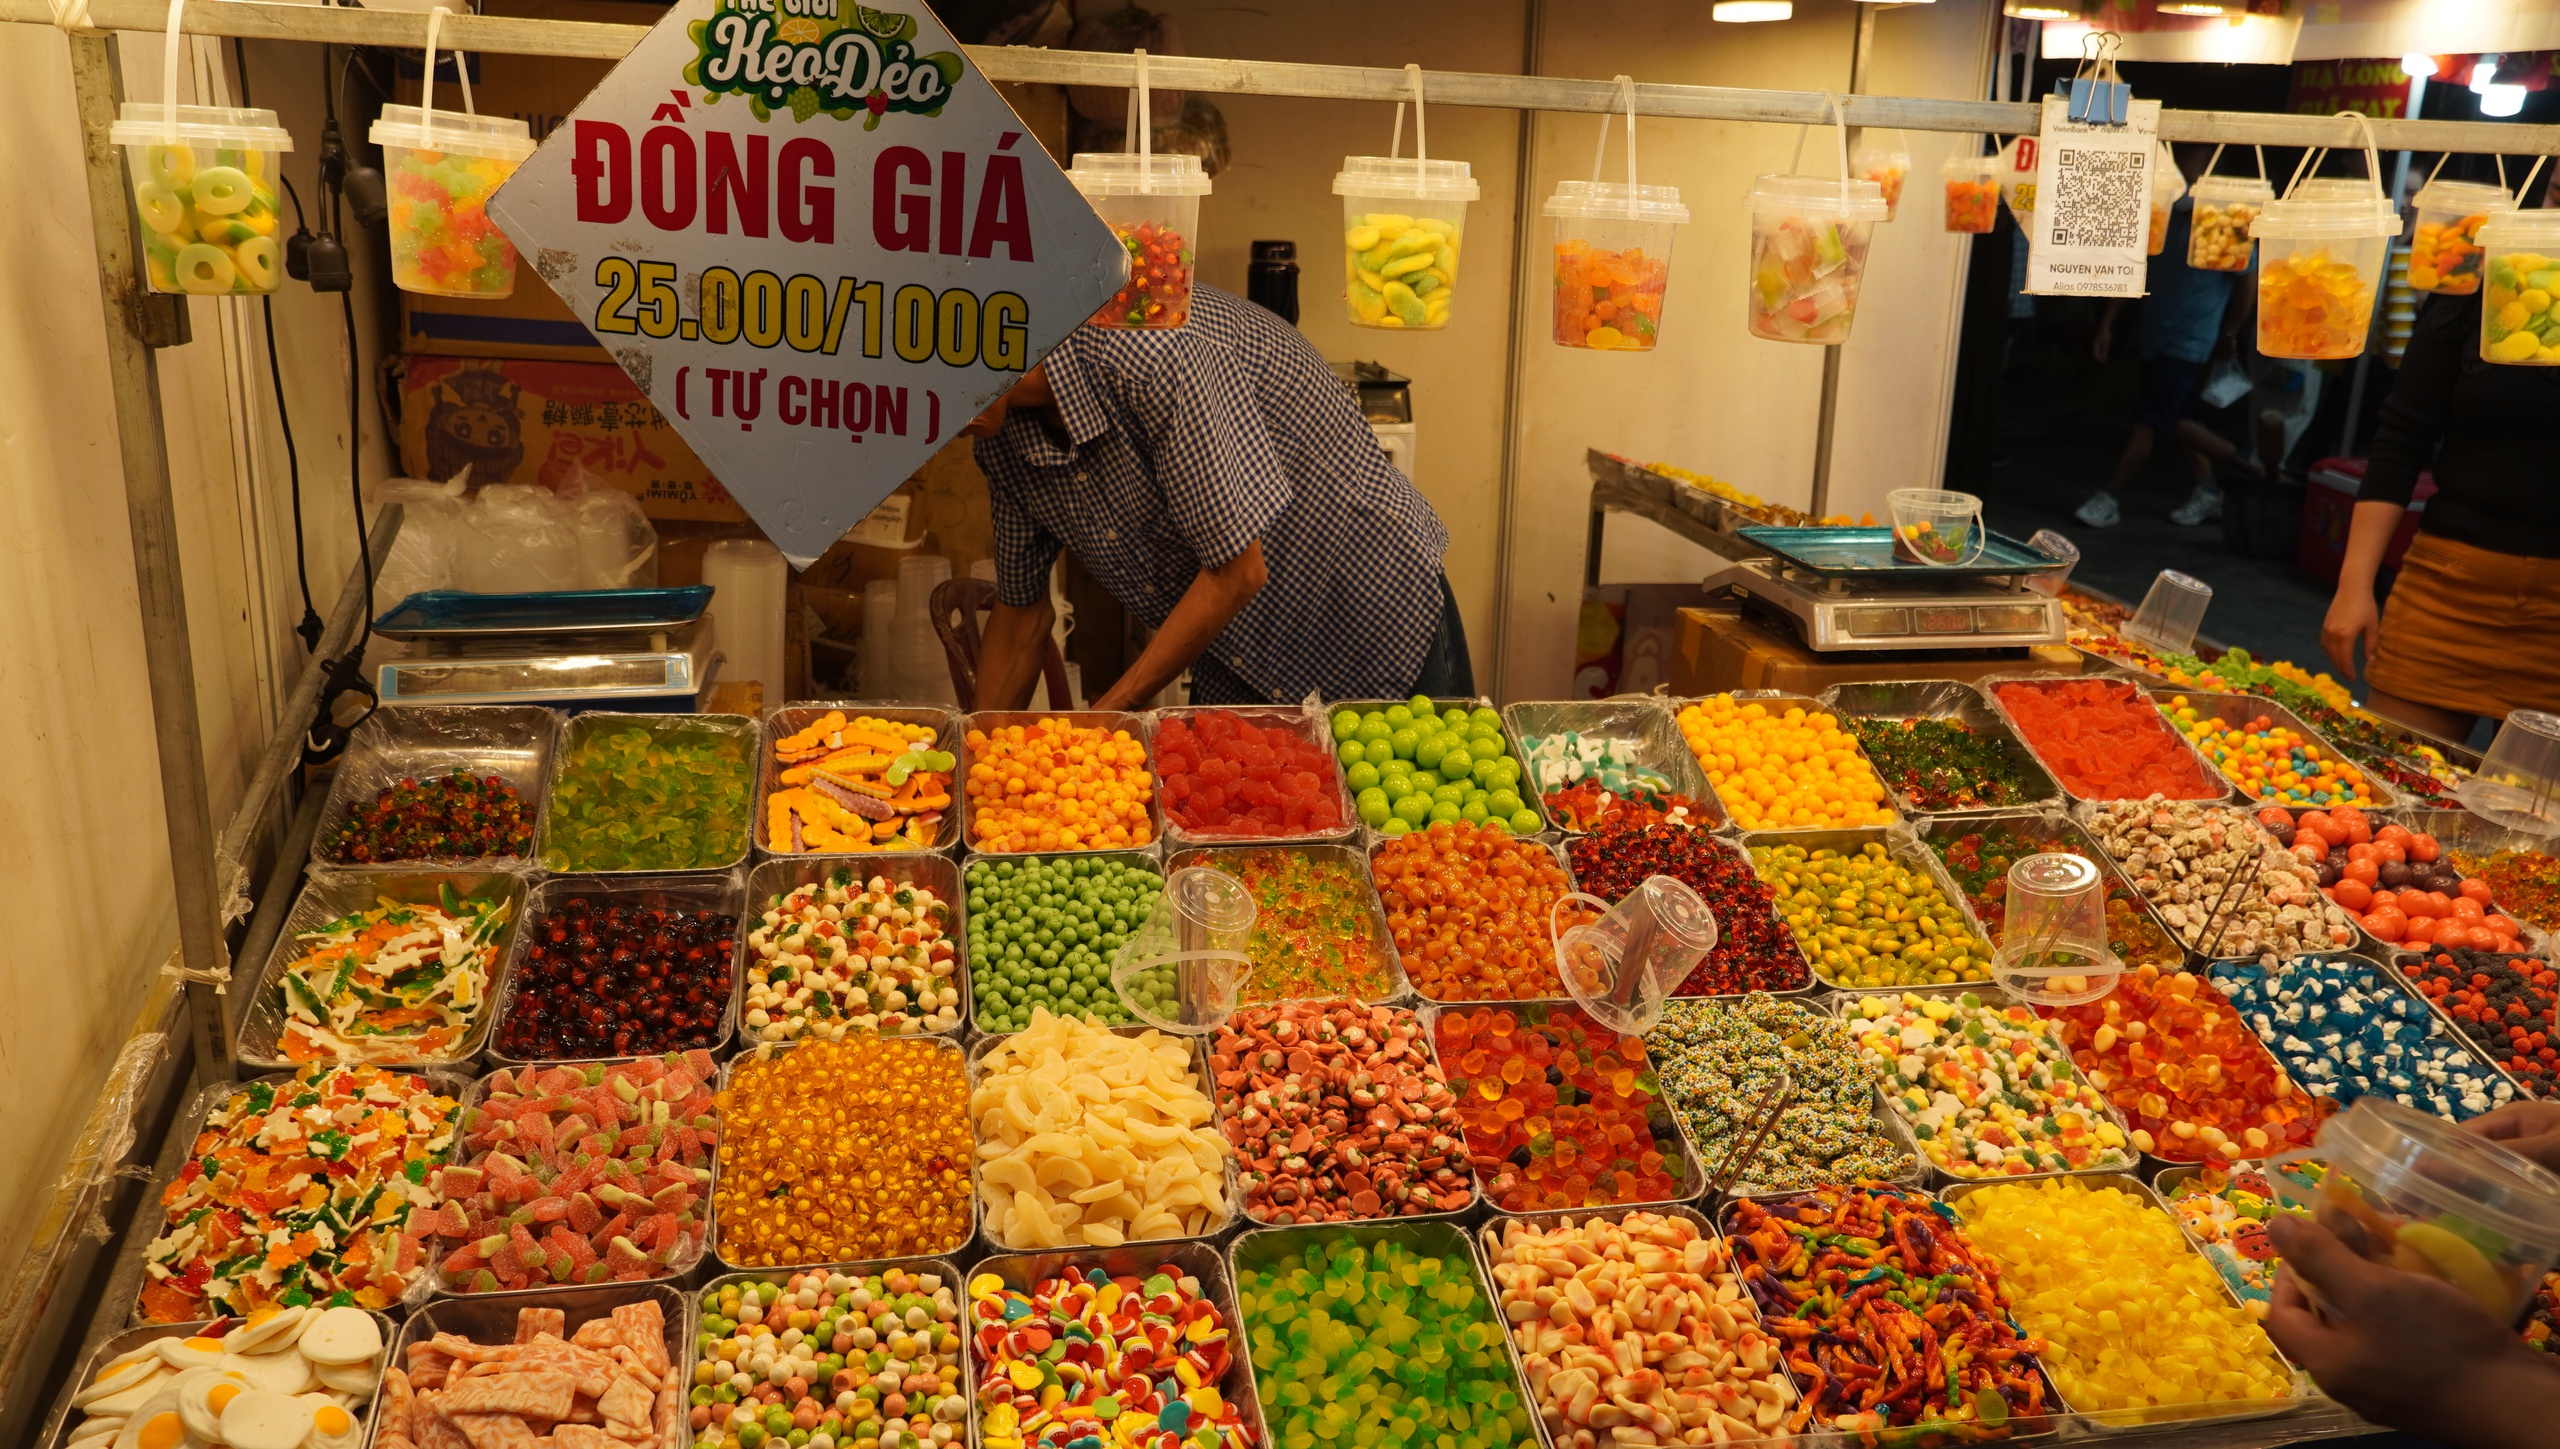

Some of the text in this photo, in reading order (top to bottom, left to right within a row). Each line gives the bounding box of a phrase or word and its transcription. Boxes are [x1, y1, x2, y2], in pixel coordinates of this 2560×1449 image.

[2053, 125, 2089, 134] VietinBank
[2014, 138, 2039, 173] Đ
[571, 89, 1035, 264] ĐỒNG GIÁ
[2049, 263, 2134, 276] NGUYEN VAN TOI
[2053, 282, 2128, 293] Alias 0978536783
[595, 256, 1030, 373] 25.000/100G
[705, 367, 767, 433] TỰ
[778, 375, 909, 444] CHỌN
